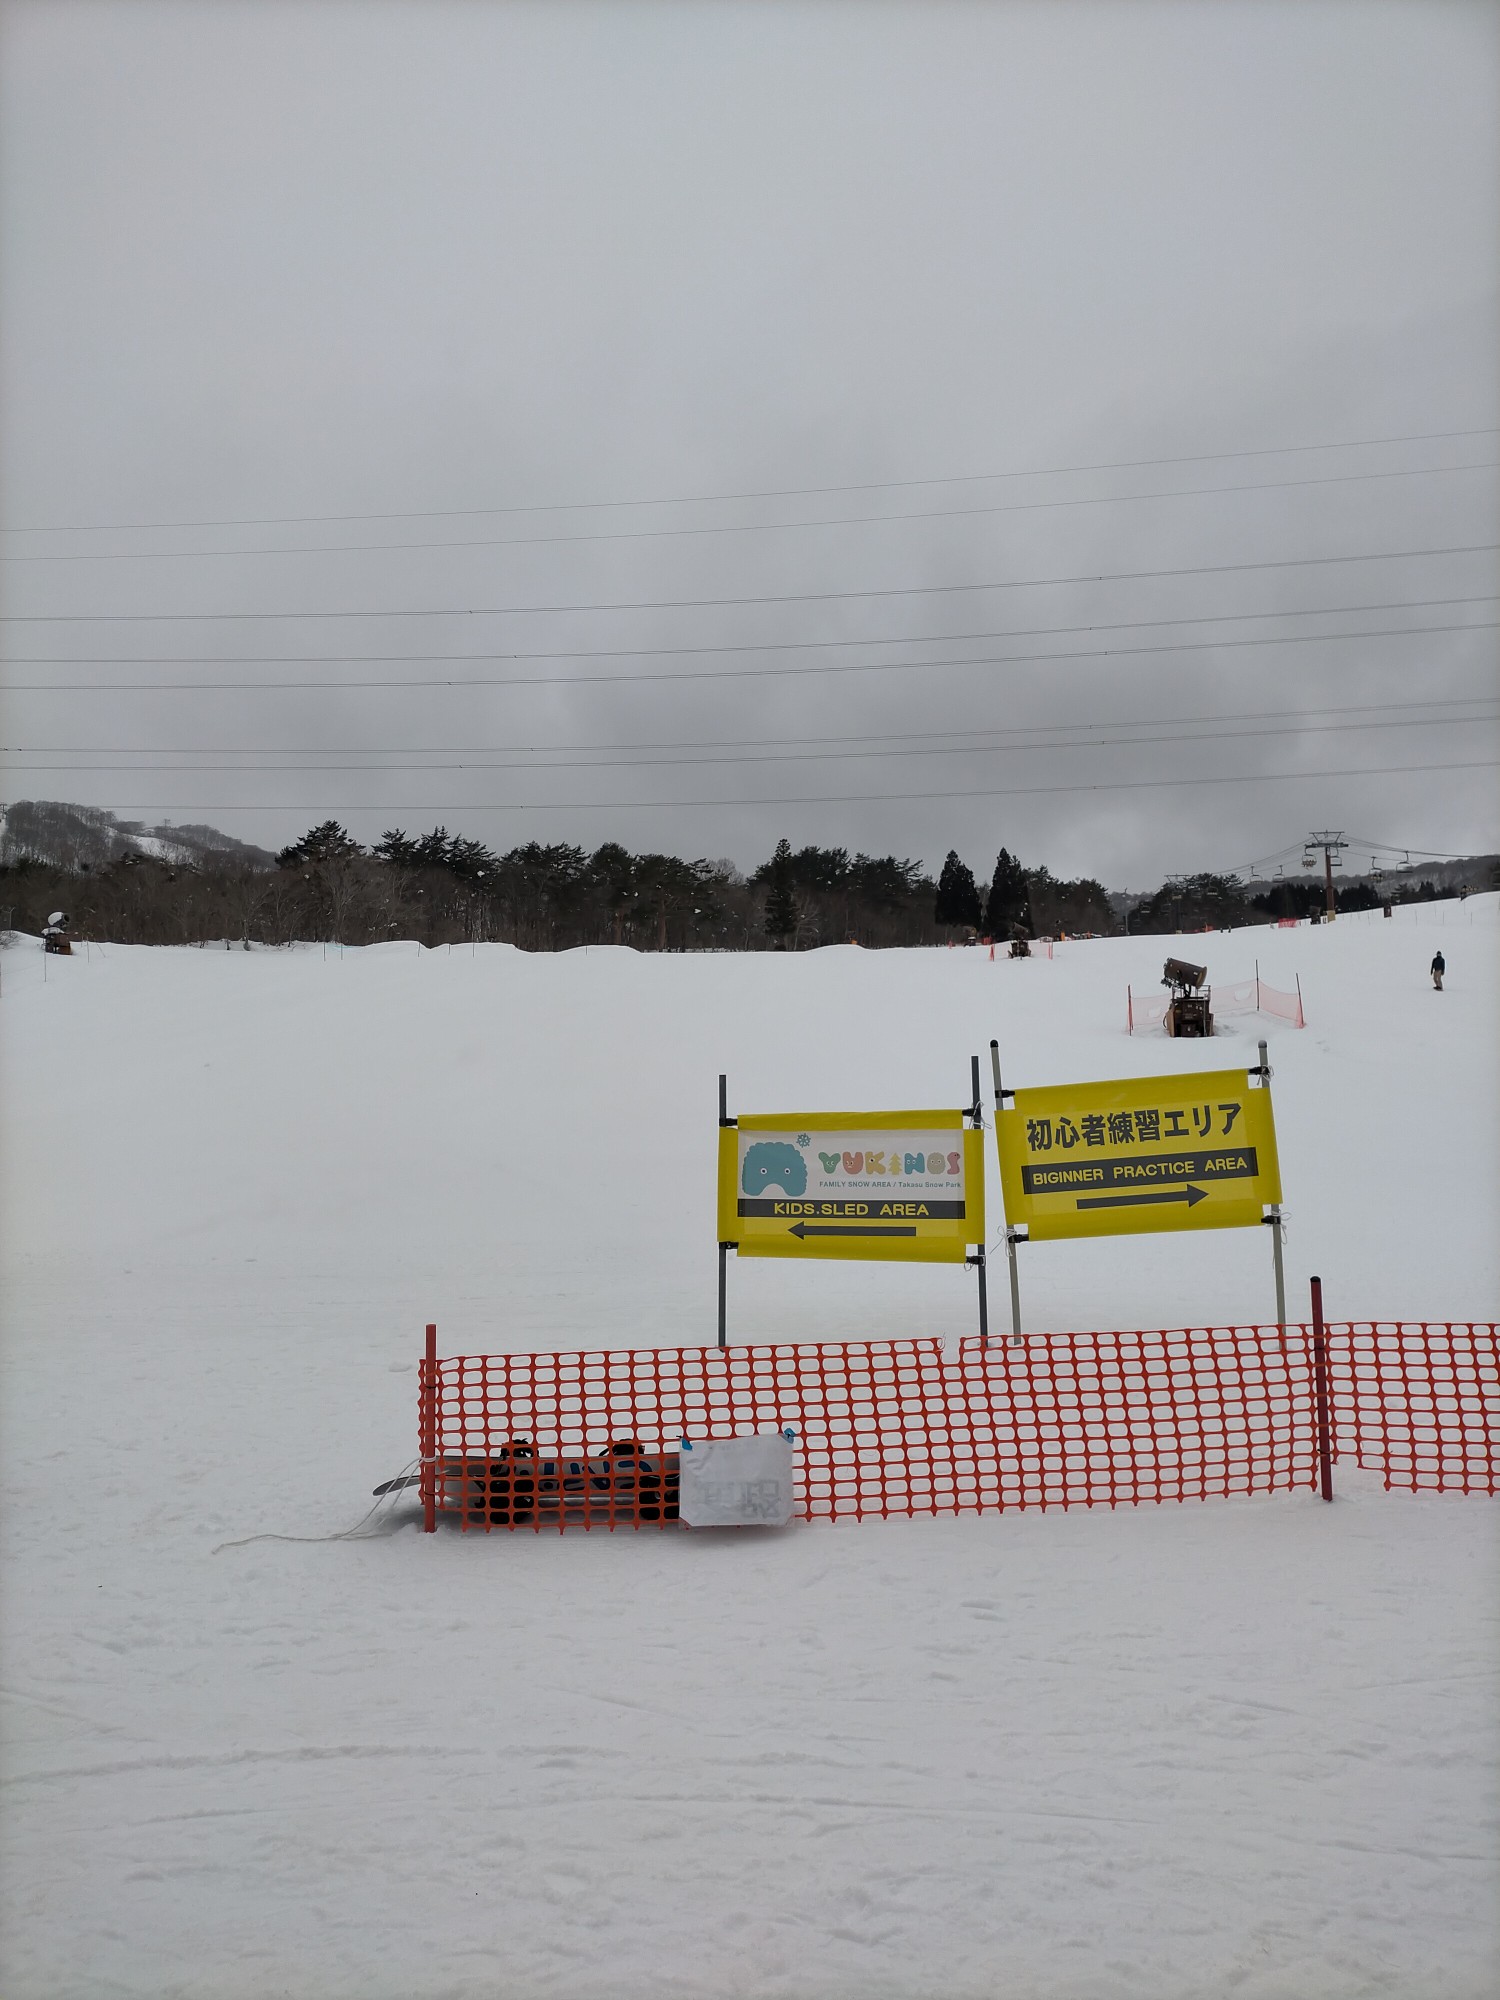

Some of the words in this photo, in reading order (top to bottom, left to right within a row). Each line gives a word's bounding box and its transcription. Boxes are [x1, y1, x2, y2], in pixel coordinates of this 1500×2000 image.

[1027, 1102, 1242, 1151] 初心者練習エリア
[1033, 1168, 1104, 1185] BIGINNER
[1113, 1161, 1195, 1179] PRACTICE
[1204, 1157, 1248, 1172] AREA
[880, 1203, 929, 1216] AREA
